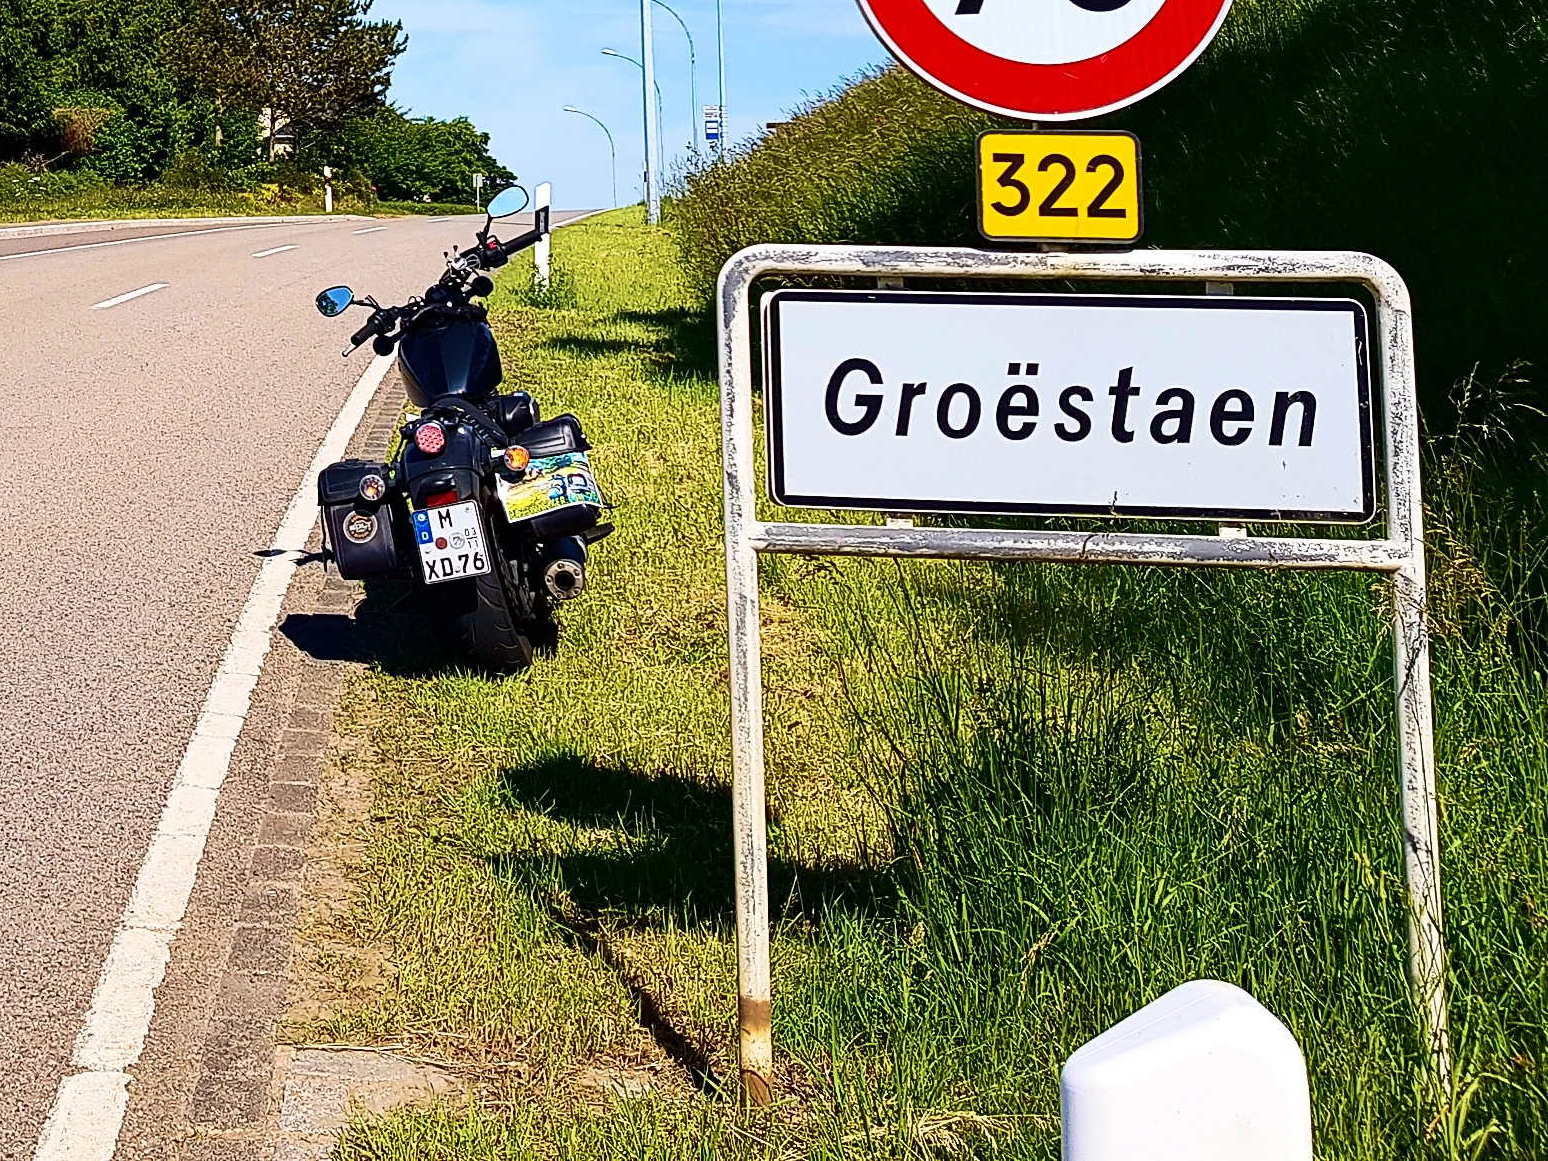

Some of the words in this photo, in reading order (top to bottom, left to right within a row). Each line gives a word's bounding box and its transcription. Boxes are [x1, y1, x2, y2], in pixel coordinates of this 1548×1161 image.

[990, 152, 1127, 218] 322
[824, 358, 1318, 448] Groëstaen
[421, 531, 429, 541] D
[438, 508, 453, 529] M
